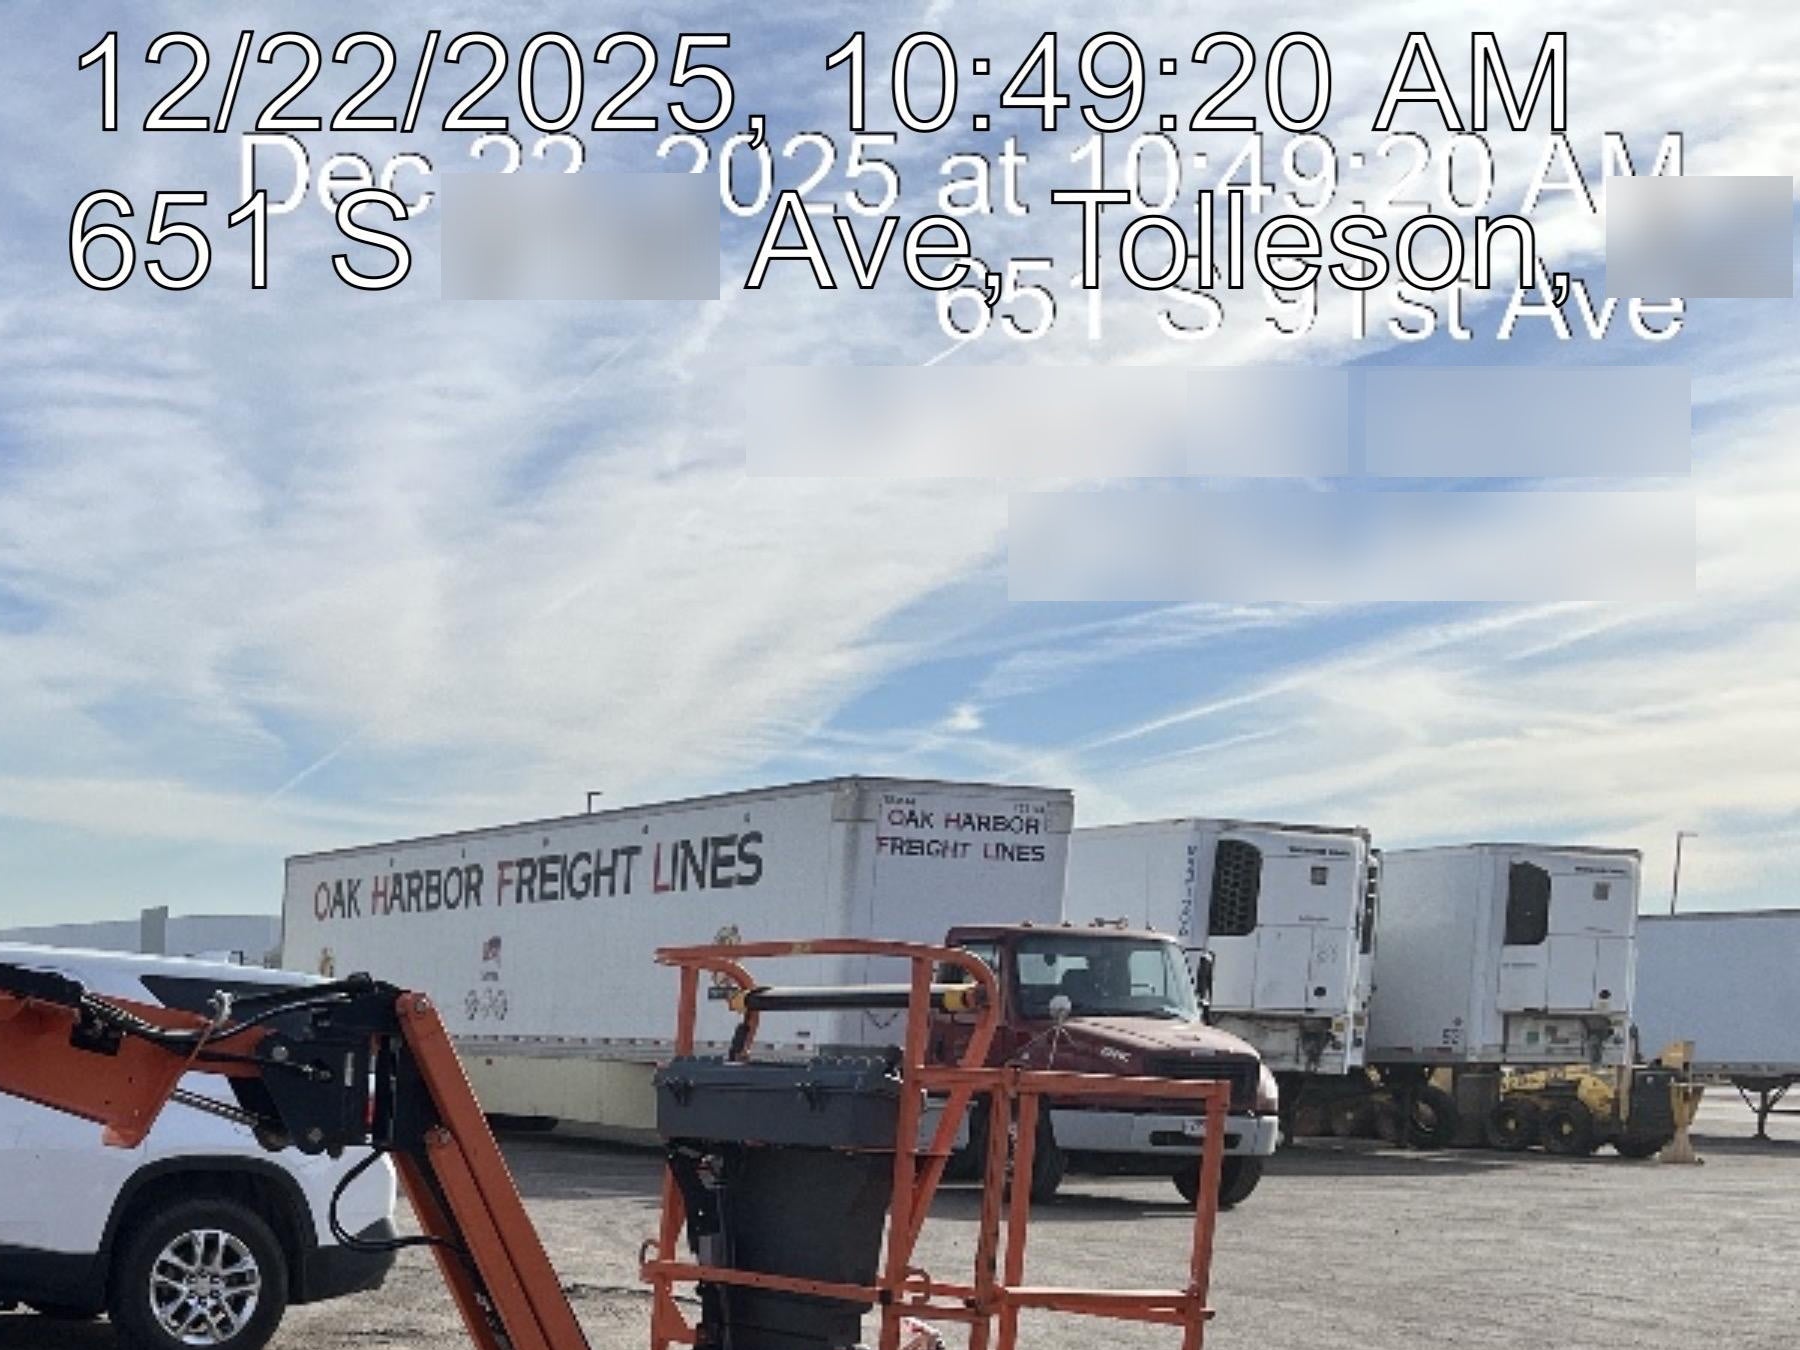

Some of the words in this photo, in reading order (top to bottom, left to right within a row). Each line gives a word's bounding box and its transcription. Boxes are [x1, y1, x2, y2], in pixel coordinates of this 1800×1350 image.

[887, 807, 935, 830] OAK
[943, 811, 1040, 835] HARBOR
[874, 835, 973, 860] FREIGHT
[983, 842, 1046, 863] LINES
[313, 878, 362, 921] OAK
[371, 863, 484, 916] HARBOR
[497, 845, 642, 907] FREIGHT
[652, 830, 764, 895] LINES
